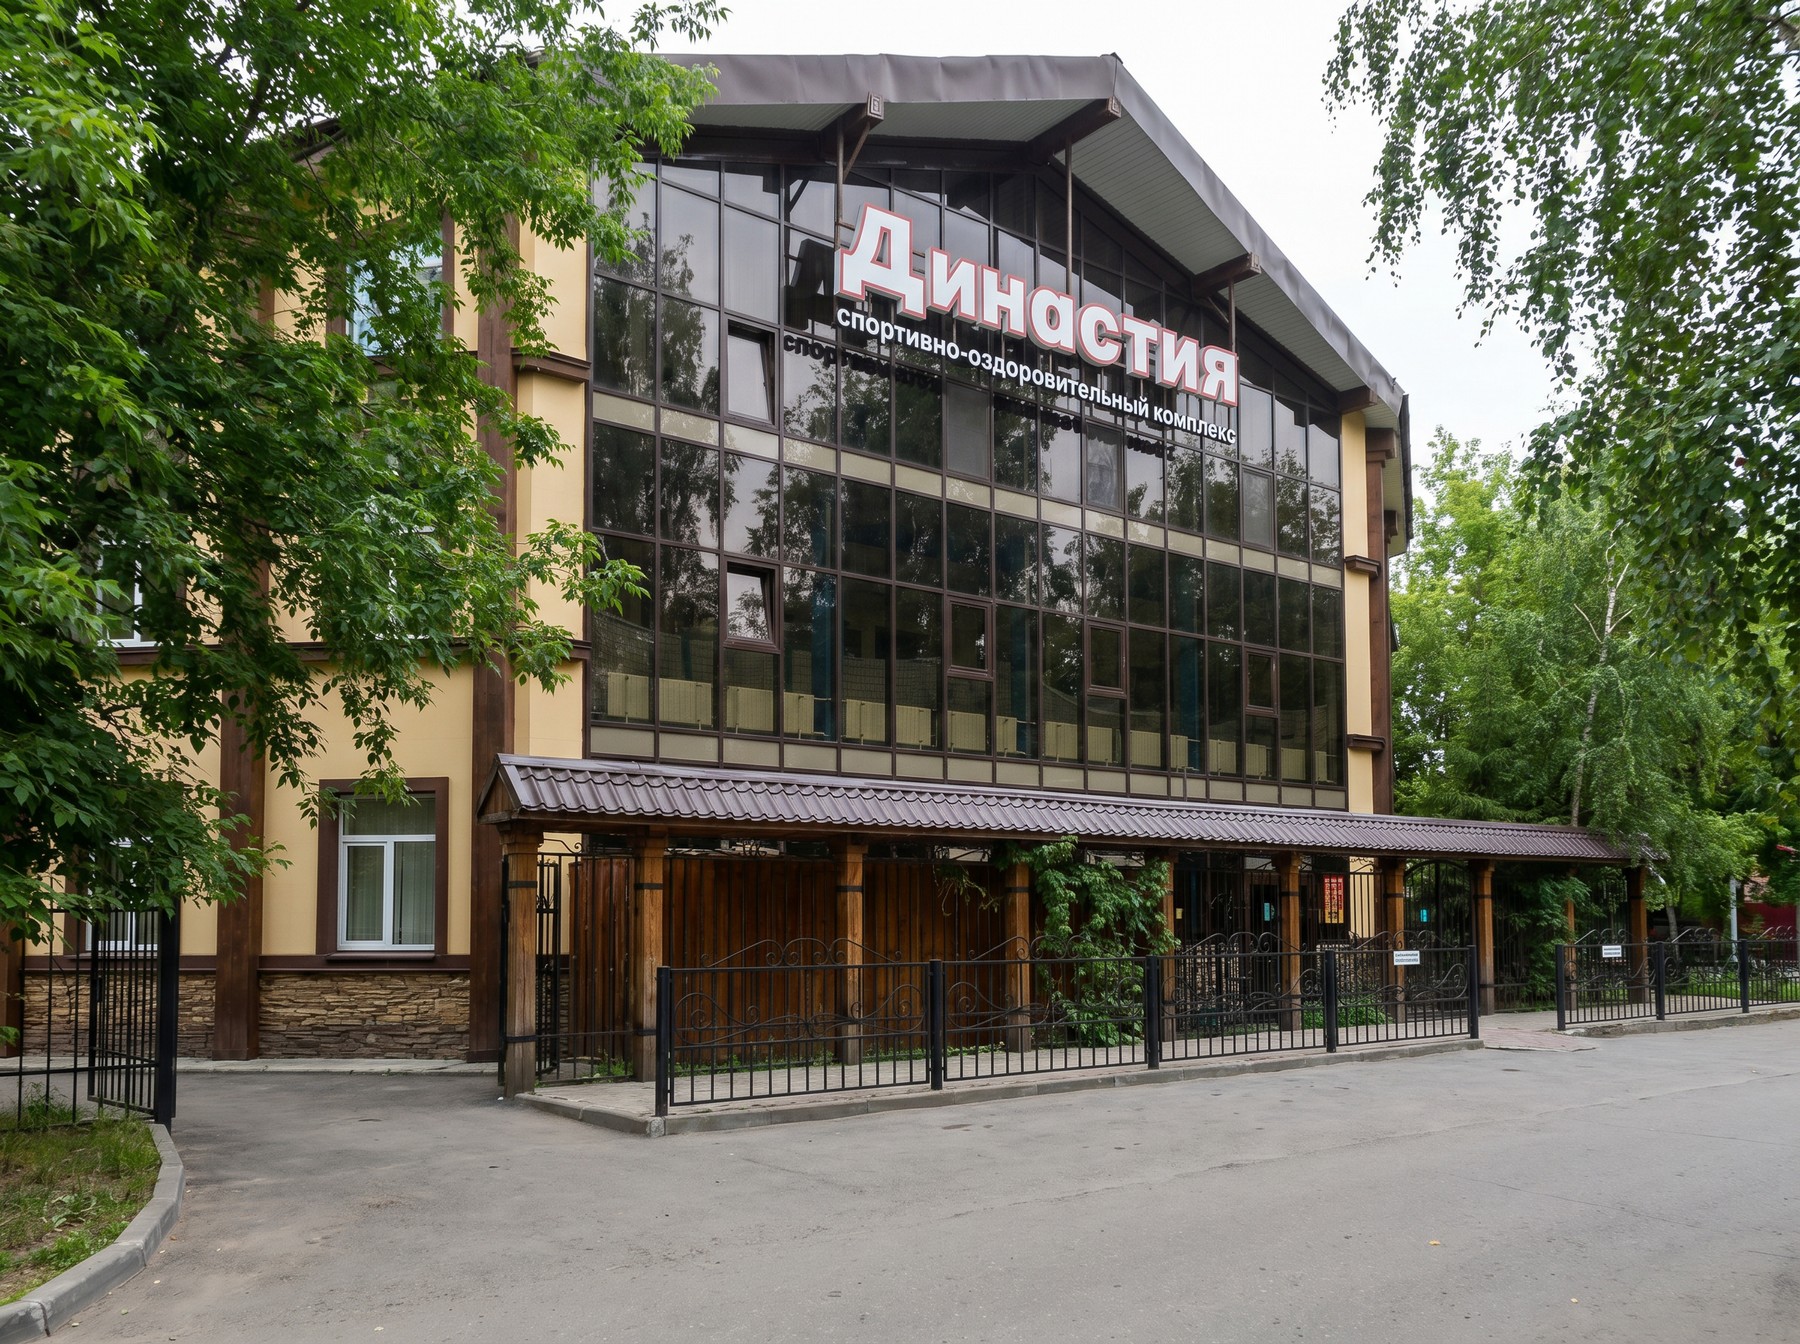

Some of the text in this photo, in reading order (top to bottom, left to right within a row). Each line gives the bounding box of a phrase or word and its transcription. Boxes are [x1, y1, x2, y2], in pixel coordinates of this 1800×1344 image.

[835, 204, 1238, 406] Династия
[837, 306, 1149, 418] спортивно-оздоровительный
[1153, 407, 1237, 444] комплекс
